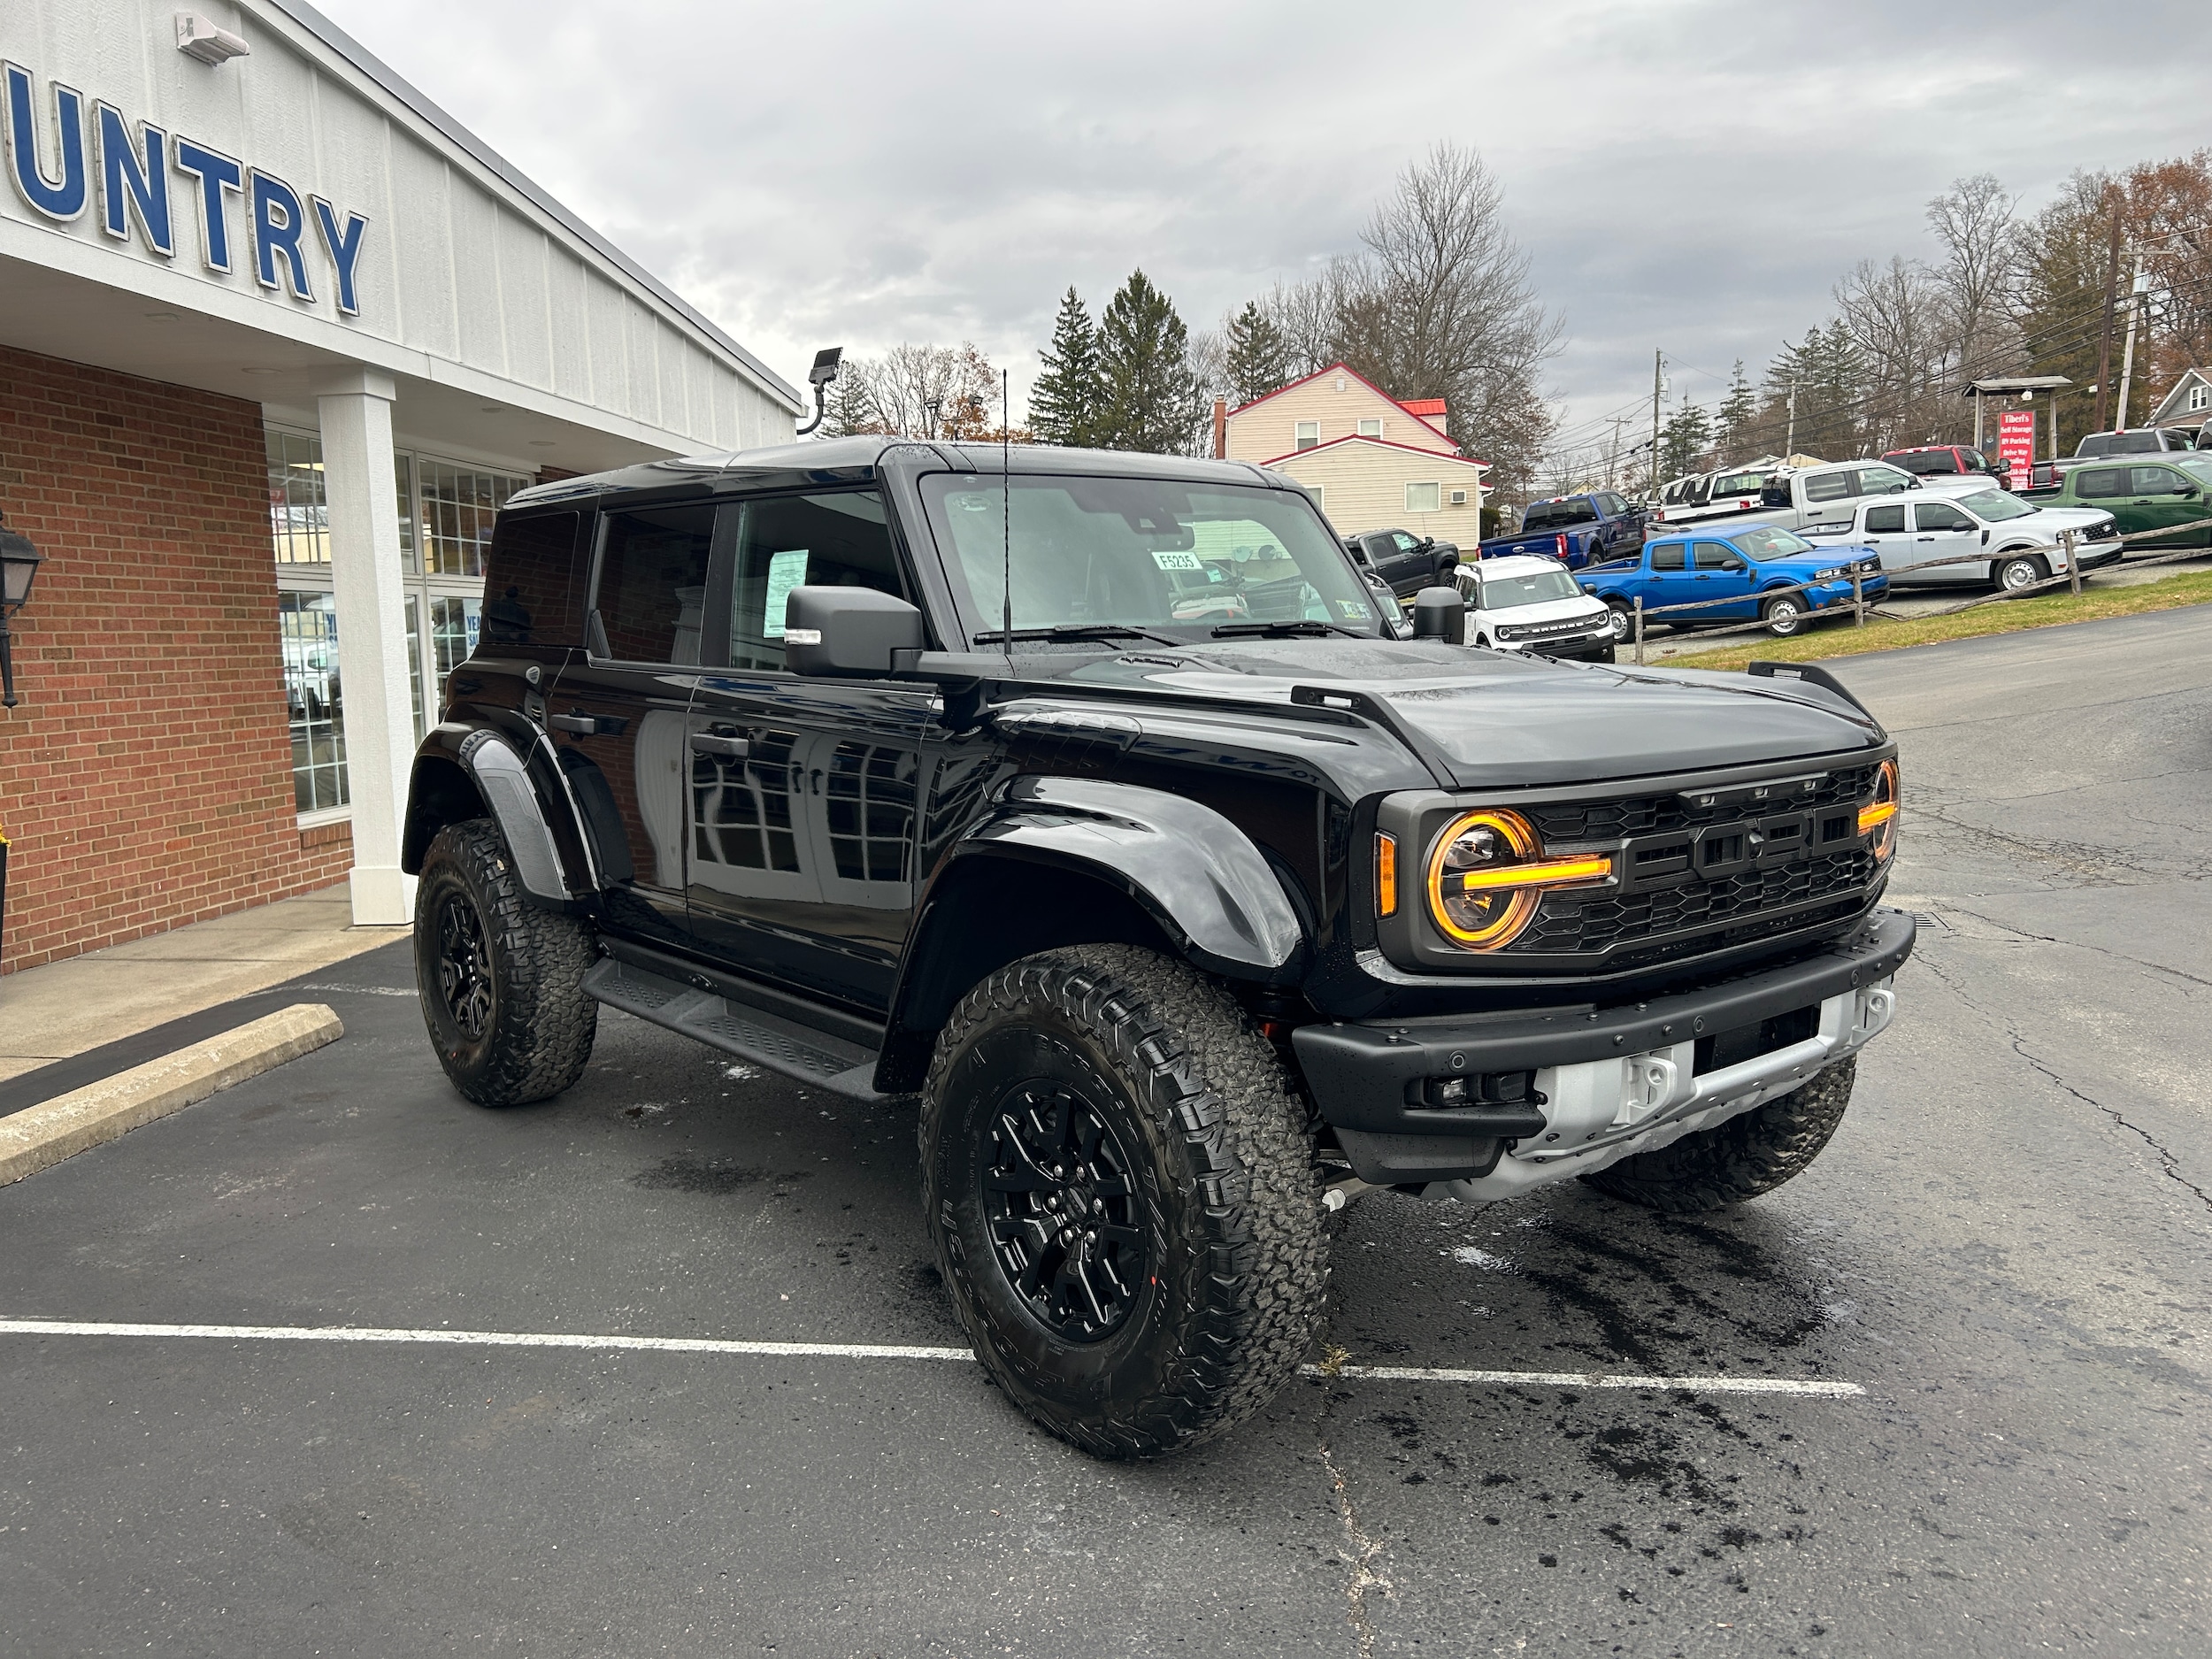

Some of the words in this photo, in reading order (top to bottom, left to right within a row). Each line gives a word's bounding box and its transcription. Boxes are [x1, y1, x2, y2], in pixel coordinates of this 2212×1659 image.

[1, 58, 370, 318] UNTRY
[1159, 555, 1194, 568] F5235
[1532, 622, 1584, 634] BRONCO
[1617, 801, 1860, 895] FORD
